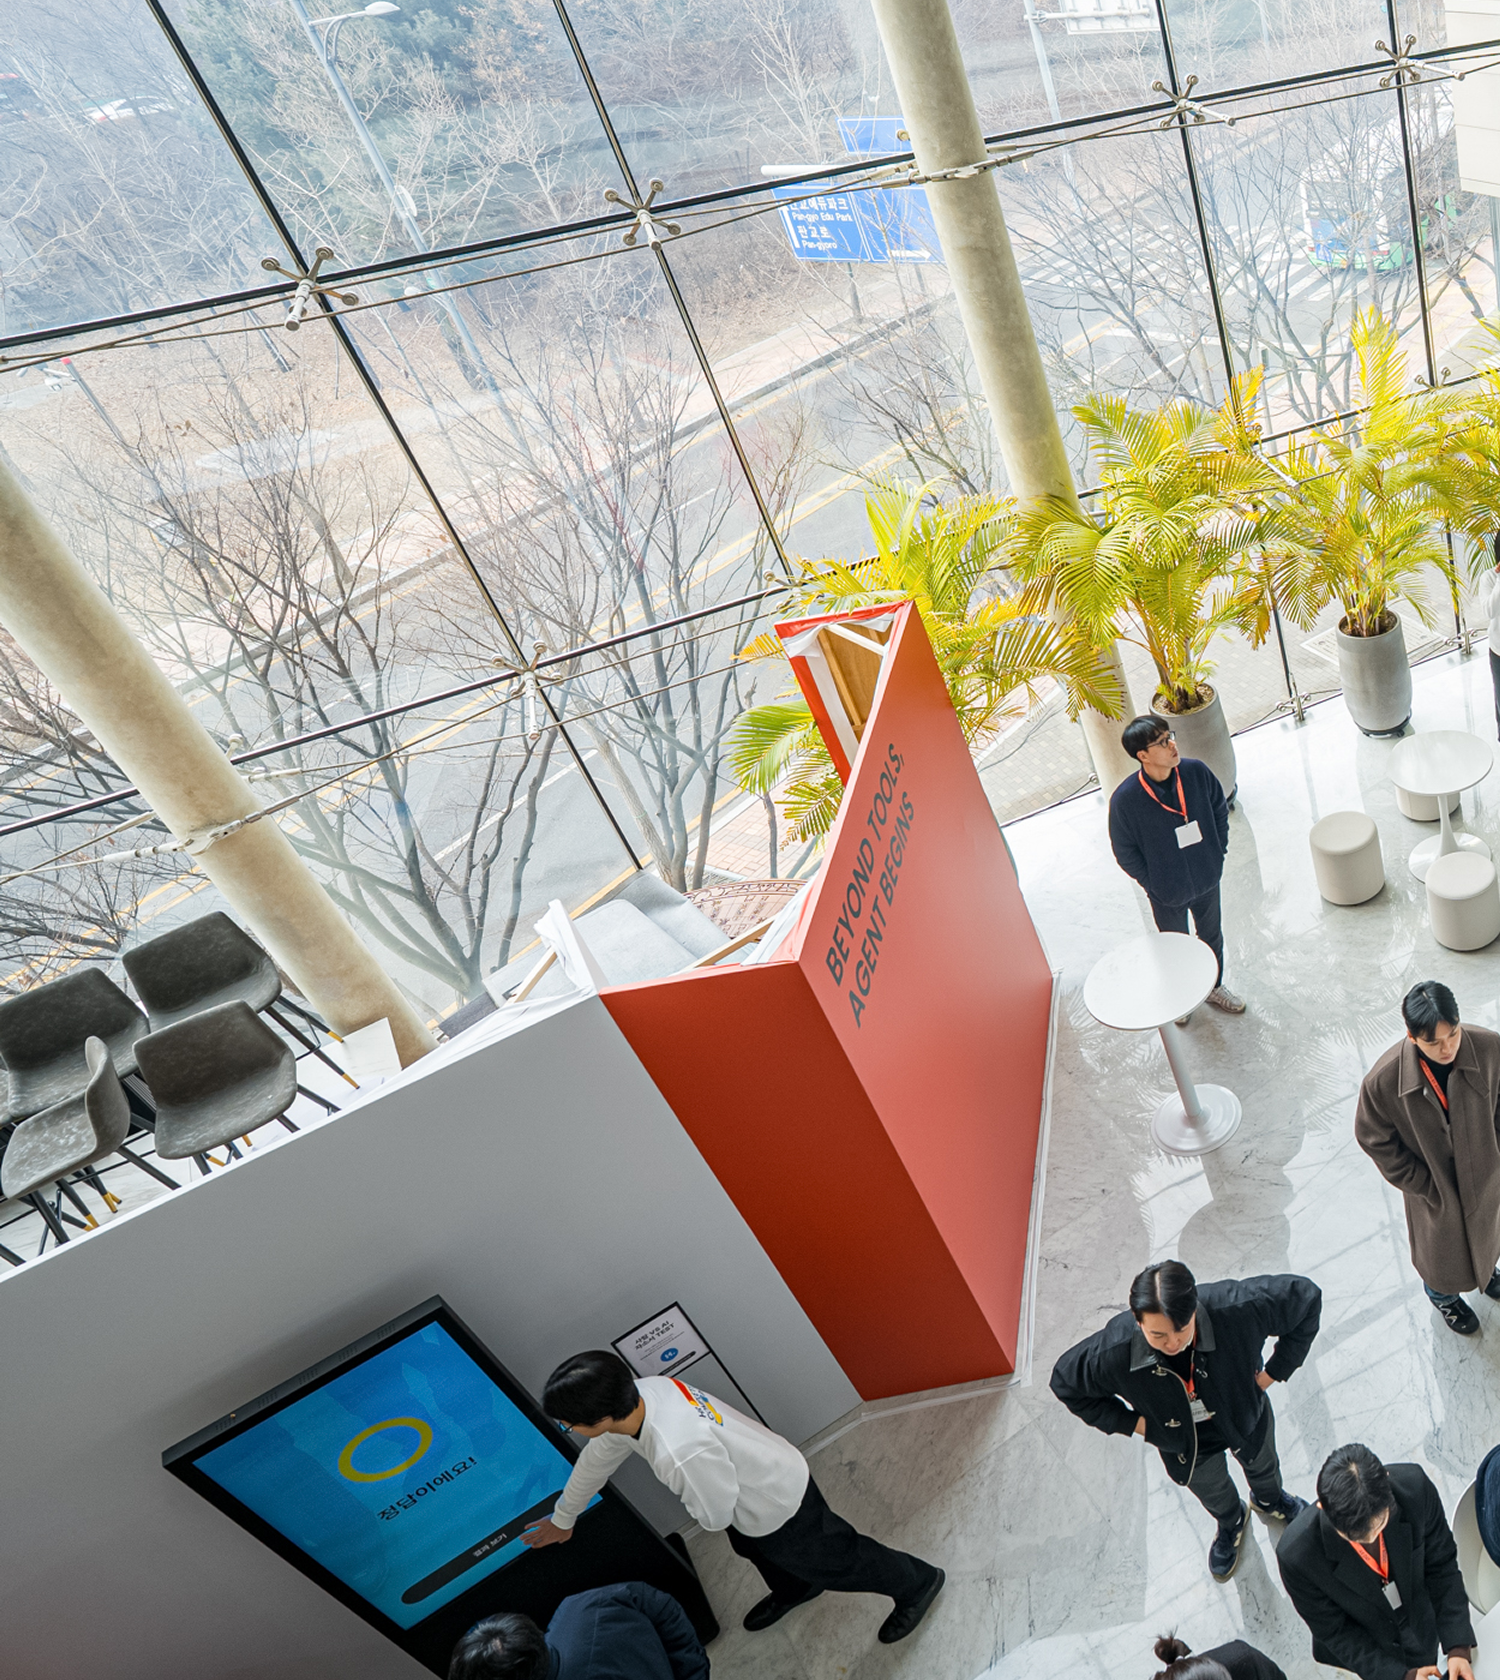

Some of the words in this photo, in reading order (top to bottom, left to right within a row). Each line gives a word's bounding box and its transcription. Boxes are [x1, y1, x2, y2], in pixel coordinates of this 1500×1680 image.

[792, 212, 819, 223] Pan-gyo
[820, 212, 834, 222] Edu
[835, 212, 853, 222] Park
[797, 225, 831, 239] 판교로
[825, 838, 875, 987] BEYOND
[866, 742, 905, 841] TOOLS,
[849, 896, 887, 1029] AGENT
[879, 790, 915, 907] BEGINS
[635, 1333, 649, 1345] 사람
[649, 1326, 661, 1335] VS
[661, 1320, 670, 1328] AI
[635, 1336, 656, 1350] 자소서
[656, 1323, 675, 1337] TEST
[377, 1456, 478, 1520] 정답이에요!
[473, 1544, 490, 1557] 결과
[490, 1533, 508, 1546] 보기
